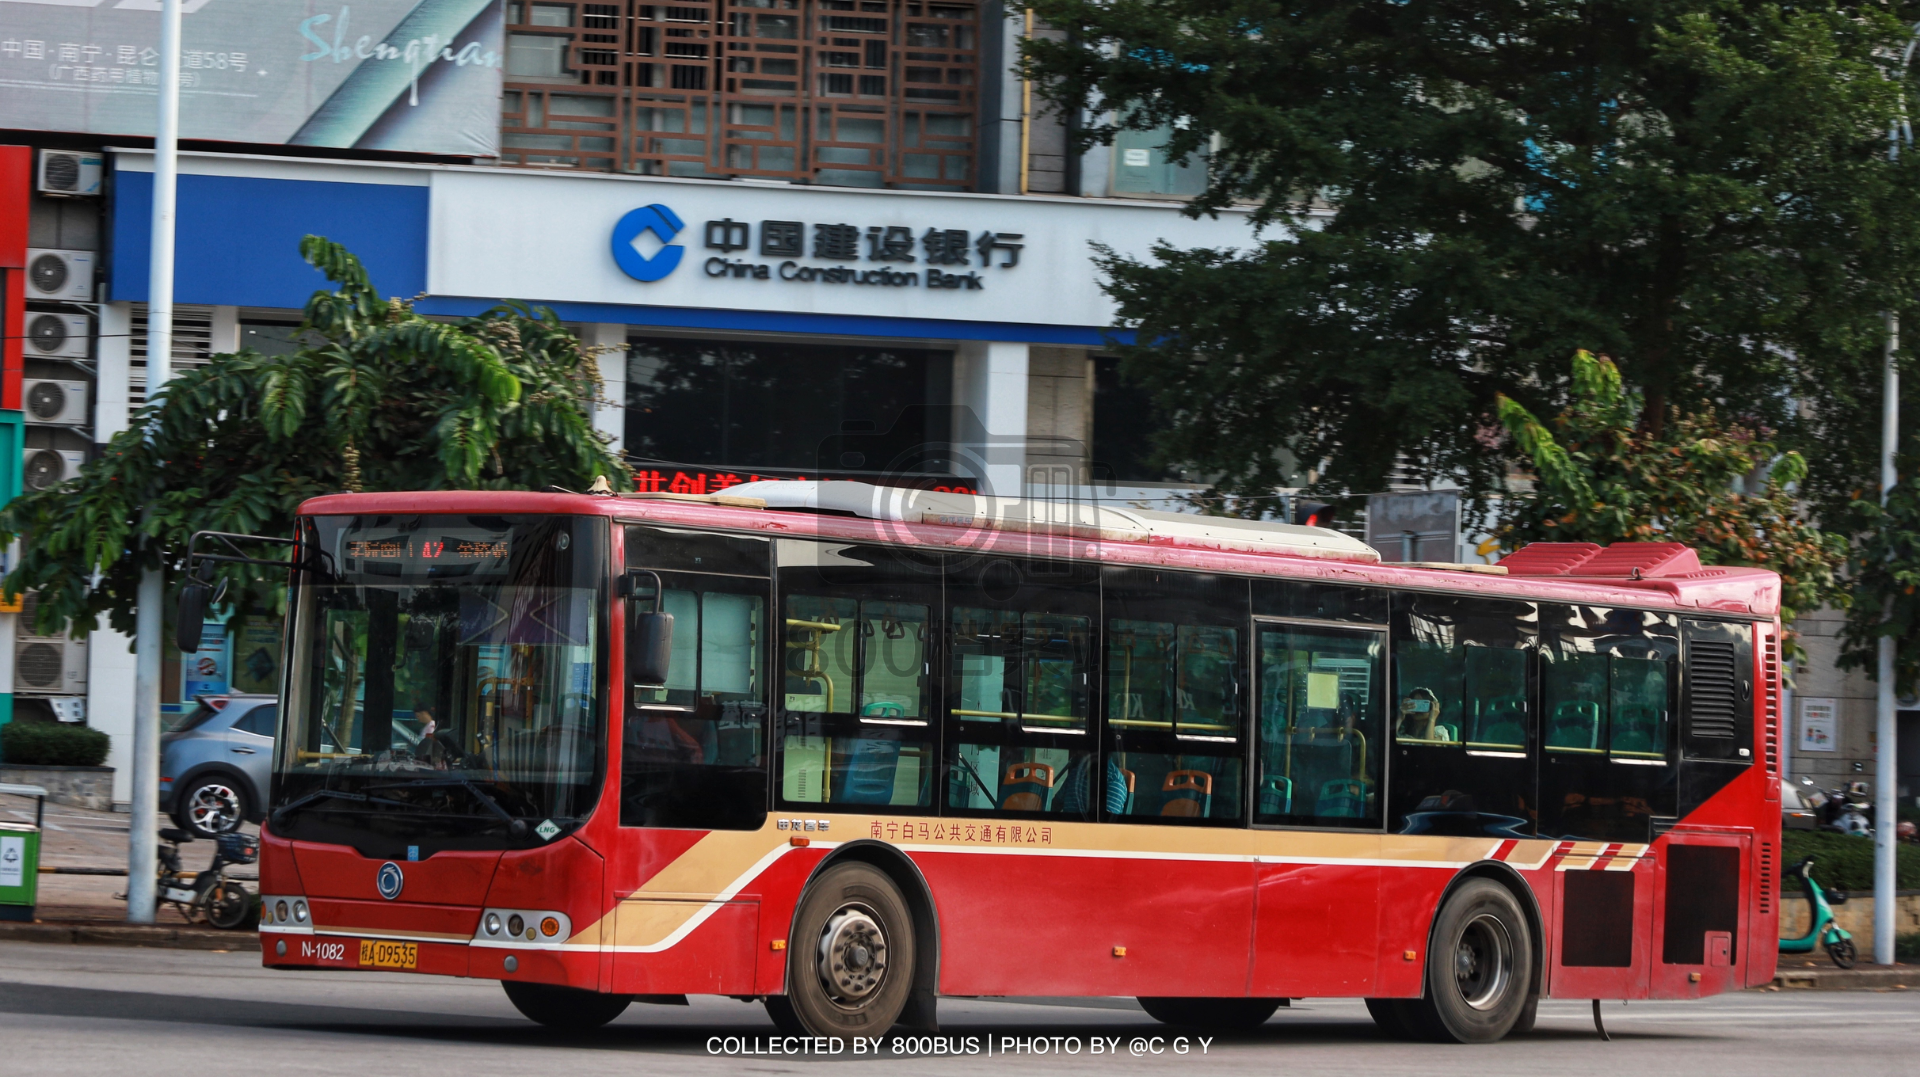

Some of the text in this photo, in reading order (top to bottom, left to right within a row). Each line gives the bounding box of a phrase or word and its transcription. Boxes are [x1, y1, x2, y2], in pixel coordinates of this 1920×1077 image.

[2, 38, 249, 72] 中国·南宁·昆仑道58号
[704, 217, 1024, 269] 中国建设银行
[704, 256, 984, 291] China Construction Bank
[539, 826, 556, 834] LNG
[869, 820, 1053, 845] 南宁白马公共交通有限公司
[301, 940, 345, 961] N-1082
